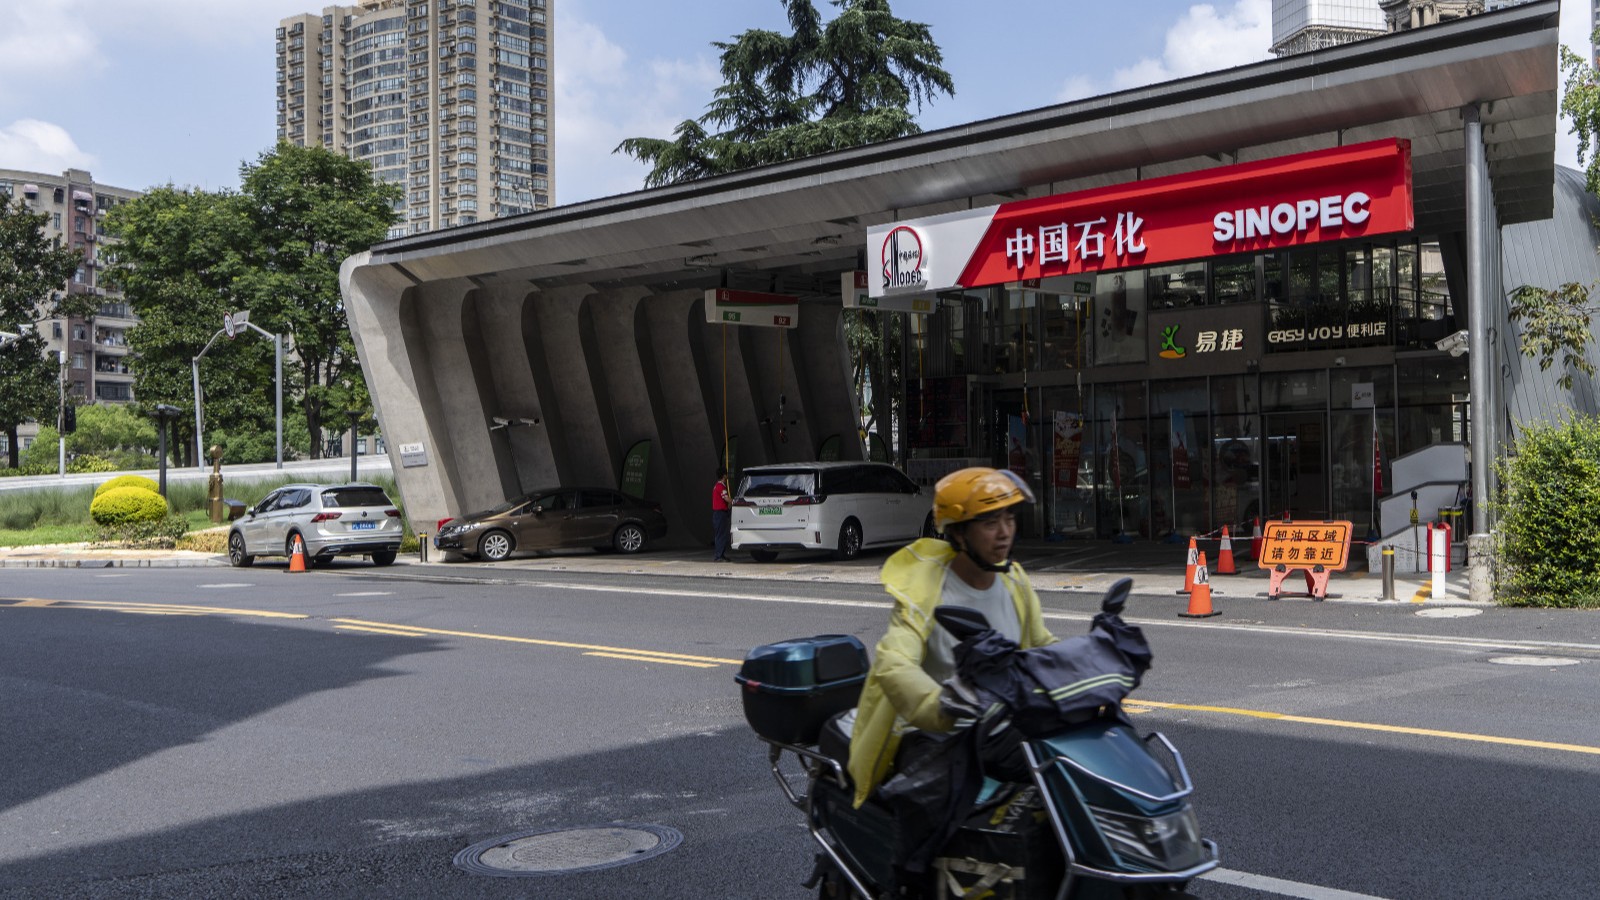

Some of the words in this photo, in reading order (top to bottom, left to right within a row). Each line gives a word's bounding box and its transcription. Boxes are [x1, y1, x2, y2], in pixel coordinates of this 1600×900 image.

[1213, 192, 1370, 242] SINOPEC
[1006, 211, 1146, 269] 中国石化
[1195, 328, 1244, 353] 易捷
[1308, 325, 1343, 341] JOY
[1346, 321, 1387, 339] 便利店
[1274, 529, 1337, 542] 卸油区域
[1272, 547, 1334, 560] 请勿靠近
